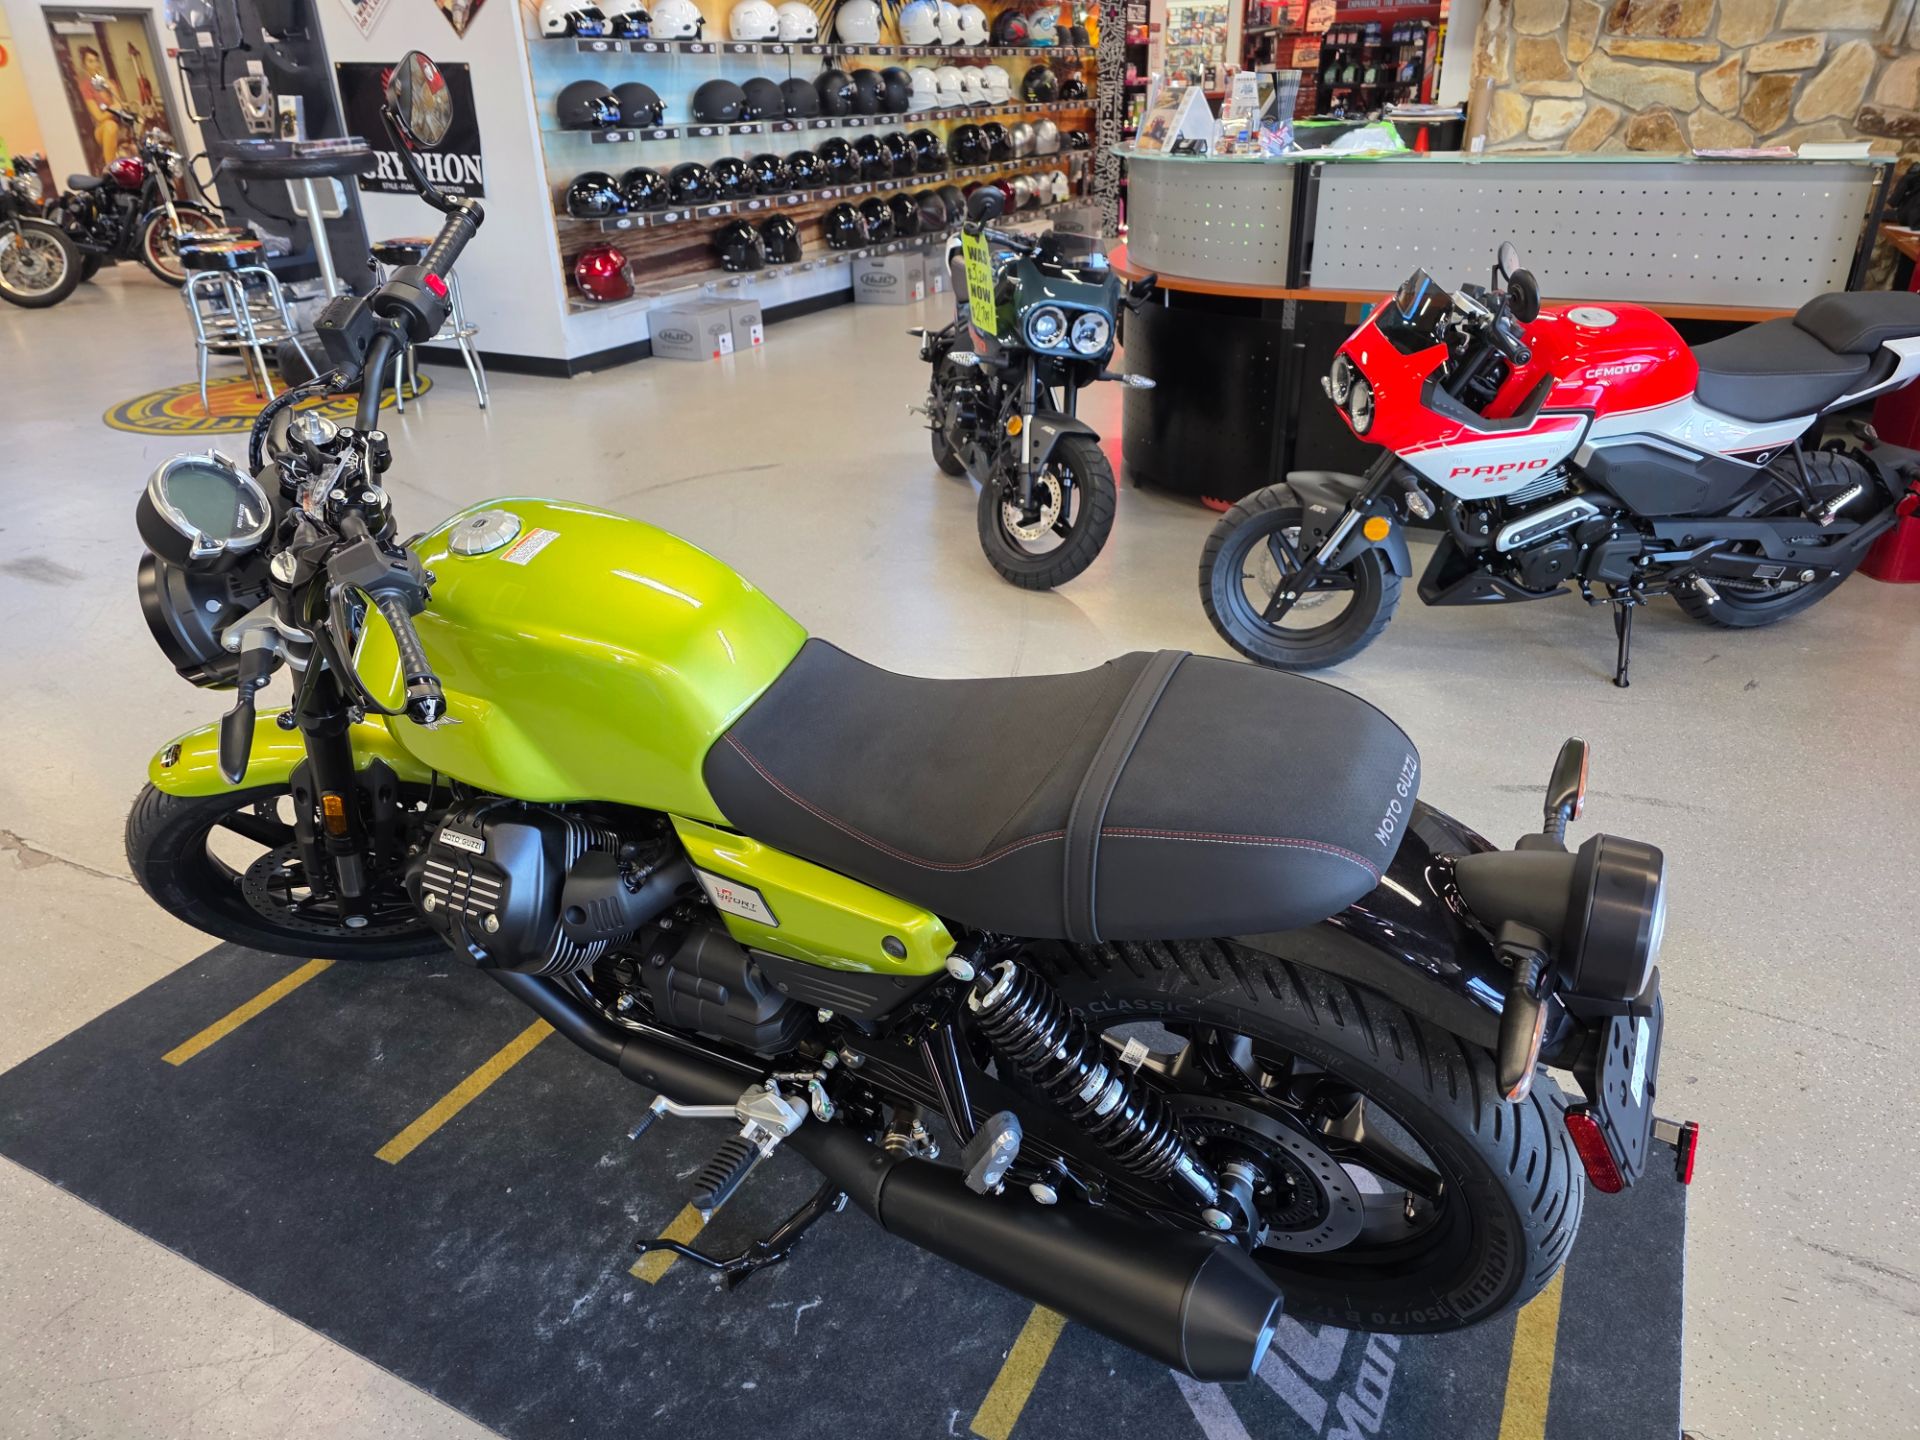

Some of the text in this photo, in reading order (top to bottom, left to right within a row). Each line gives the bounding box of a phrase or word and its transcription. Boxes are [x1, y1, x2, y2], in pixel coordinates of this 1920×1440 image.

[968, 246, 988, 265] WAS
[971, 282, 991, 304] NOW
[1585, 363, 1642, 380] CFMOTO
[1449, 458, 1549, 479] PAPIO
[1374, 753, 1418, 847] MOTO GUZZI
[441, 831, 481, 851] MOTO GUZZI
[1088, 999, 1193, 1014] CLASSIC
[1454, 1221, 1509, 1312] MICHELIN
[1371, 1305, 1450, 1325] 150/70
